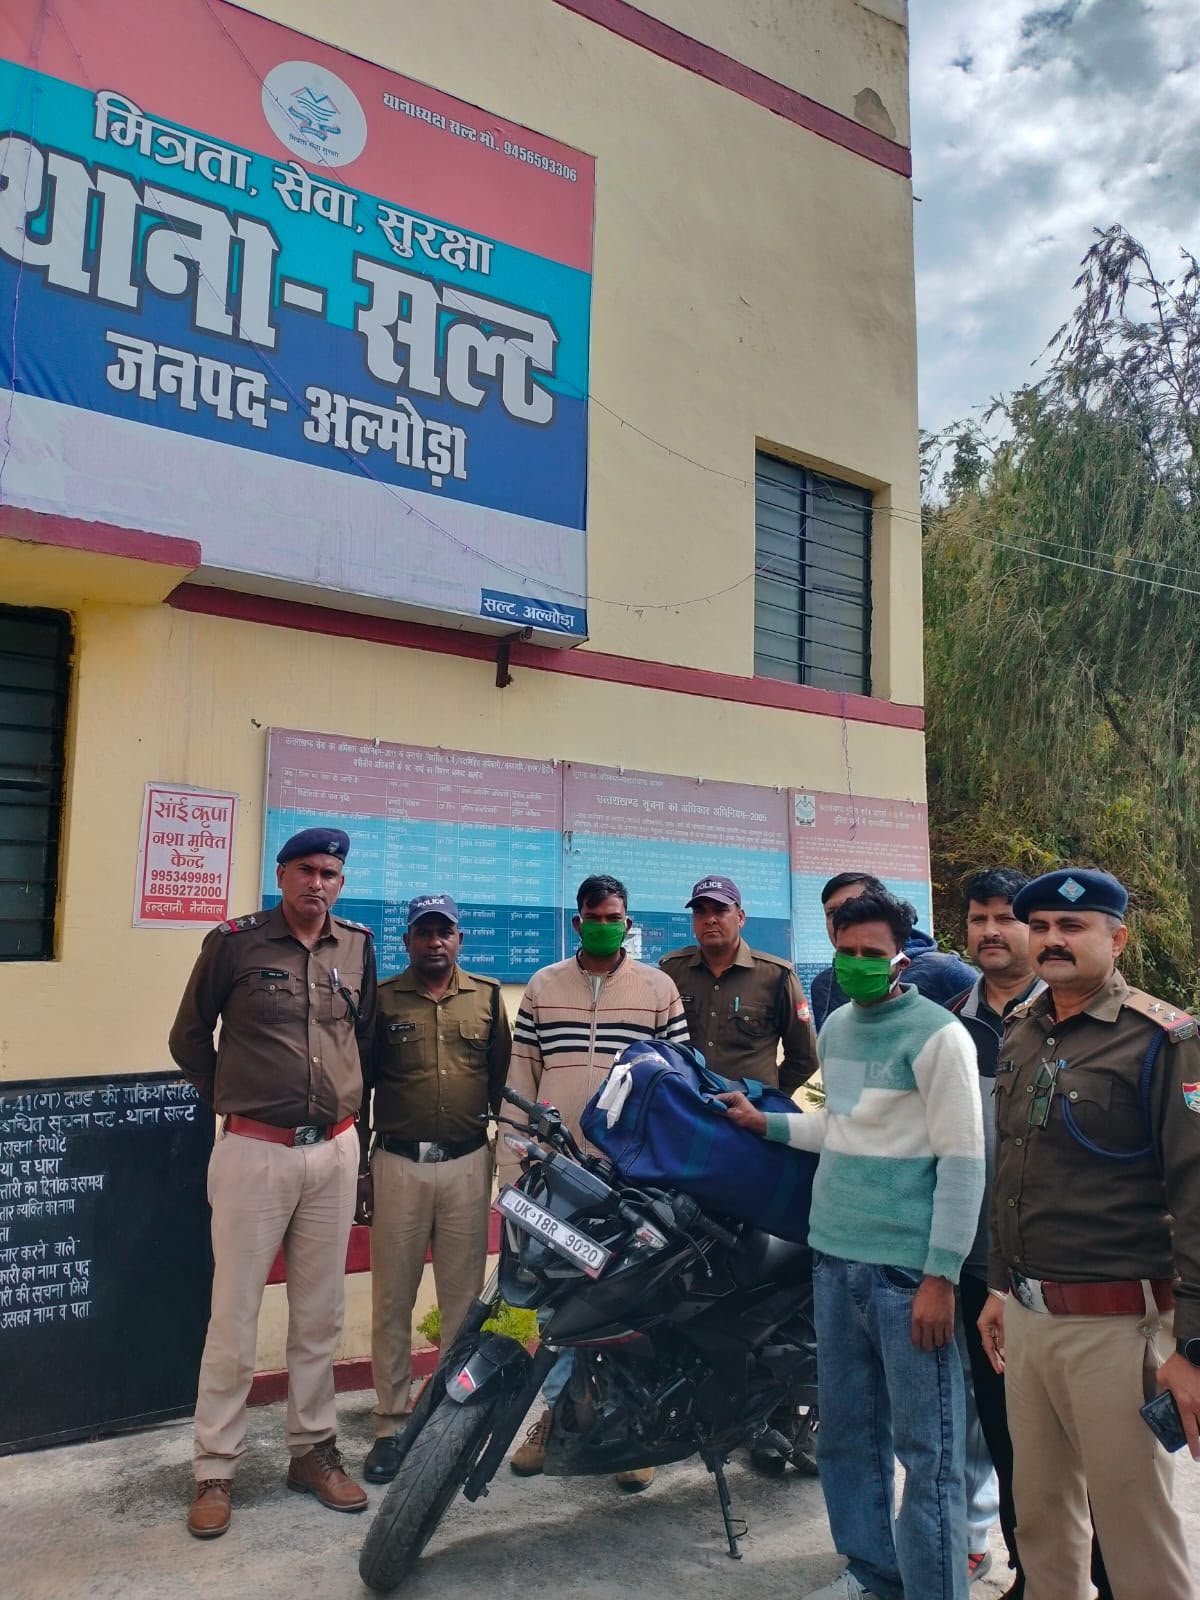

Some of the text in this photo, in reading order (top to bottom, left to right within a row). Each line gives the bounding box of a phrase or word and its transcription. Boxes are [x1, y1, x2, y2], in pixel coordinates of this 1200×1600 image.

[383, 91, 446, 130] थानाध्यक्ष
[448, 119, 477, 141] सल्ट
[503, 141, 577, 182] 9456593306
[94, 90, 494, 275] मित्रता, सेवा, सुरक्षा
[355, 258, 558, 425] सल्ट
[303, 387, 467, 488] अल्मोड़ा
[523, 605, 575, 628] अल्मोड़ा
[595, 794, 639, 808] उत्तराखण्ड
[642, 799, 664, 812] सूचना
[668, 802, 678, 813] का
[681, 802, 710, 815] अधिकार
[192, 804, 228, 829] कृपा
[152, 831, 226, 852] नशा मुक्ति
[171, 849, 204, 869] केन्द्र
[151, 870, 222, 884] 9953499891
[696, 881, 723, 892] POLICE
[150, 883, 222, 897] 8859272000
[189, 899, 224, 914] नैनीताल
[417, 898, 446, 907] POLICE
[48, 1113, 90, 1136] सूचना
[126, 1108, 161, 1125] थाना
[163, 1105, 197, 1121] सल्ट
[36, 1134, 68, 1153] रिपोर्ट
[19, 1160, 32, 1176] व
[34, 1158, 63, 1174] धारा
[24, 1181, 38, 1196] का
[21, 1240, 49, 1260] करने
[53, 1236, 81, 1257] वाले
[565, 1234, 598, 1263] 9020
[22, 1267, 36, 1281] का
[37, 1264, 60, 1279] नाम
[62, 1262, 73, 1278] व
[75, 1260, 92, 1277] पद
[15, 1283, 31, 1304] की
[32, 1283, 66, 1305] सूचना
[1, 1301, 93, 1329] उसका नाम व पता
